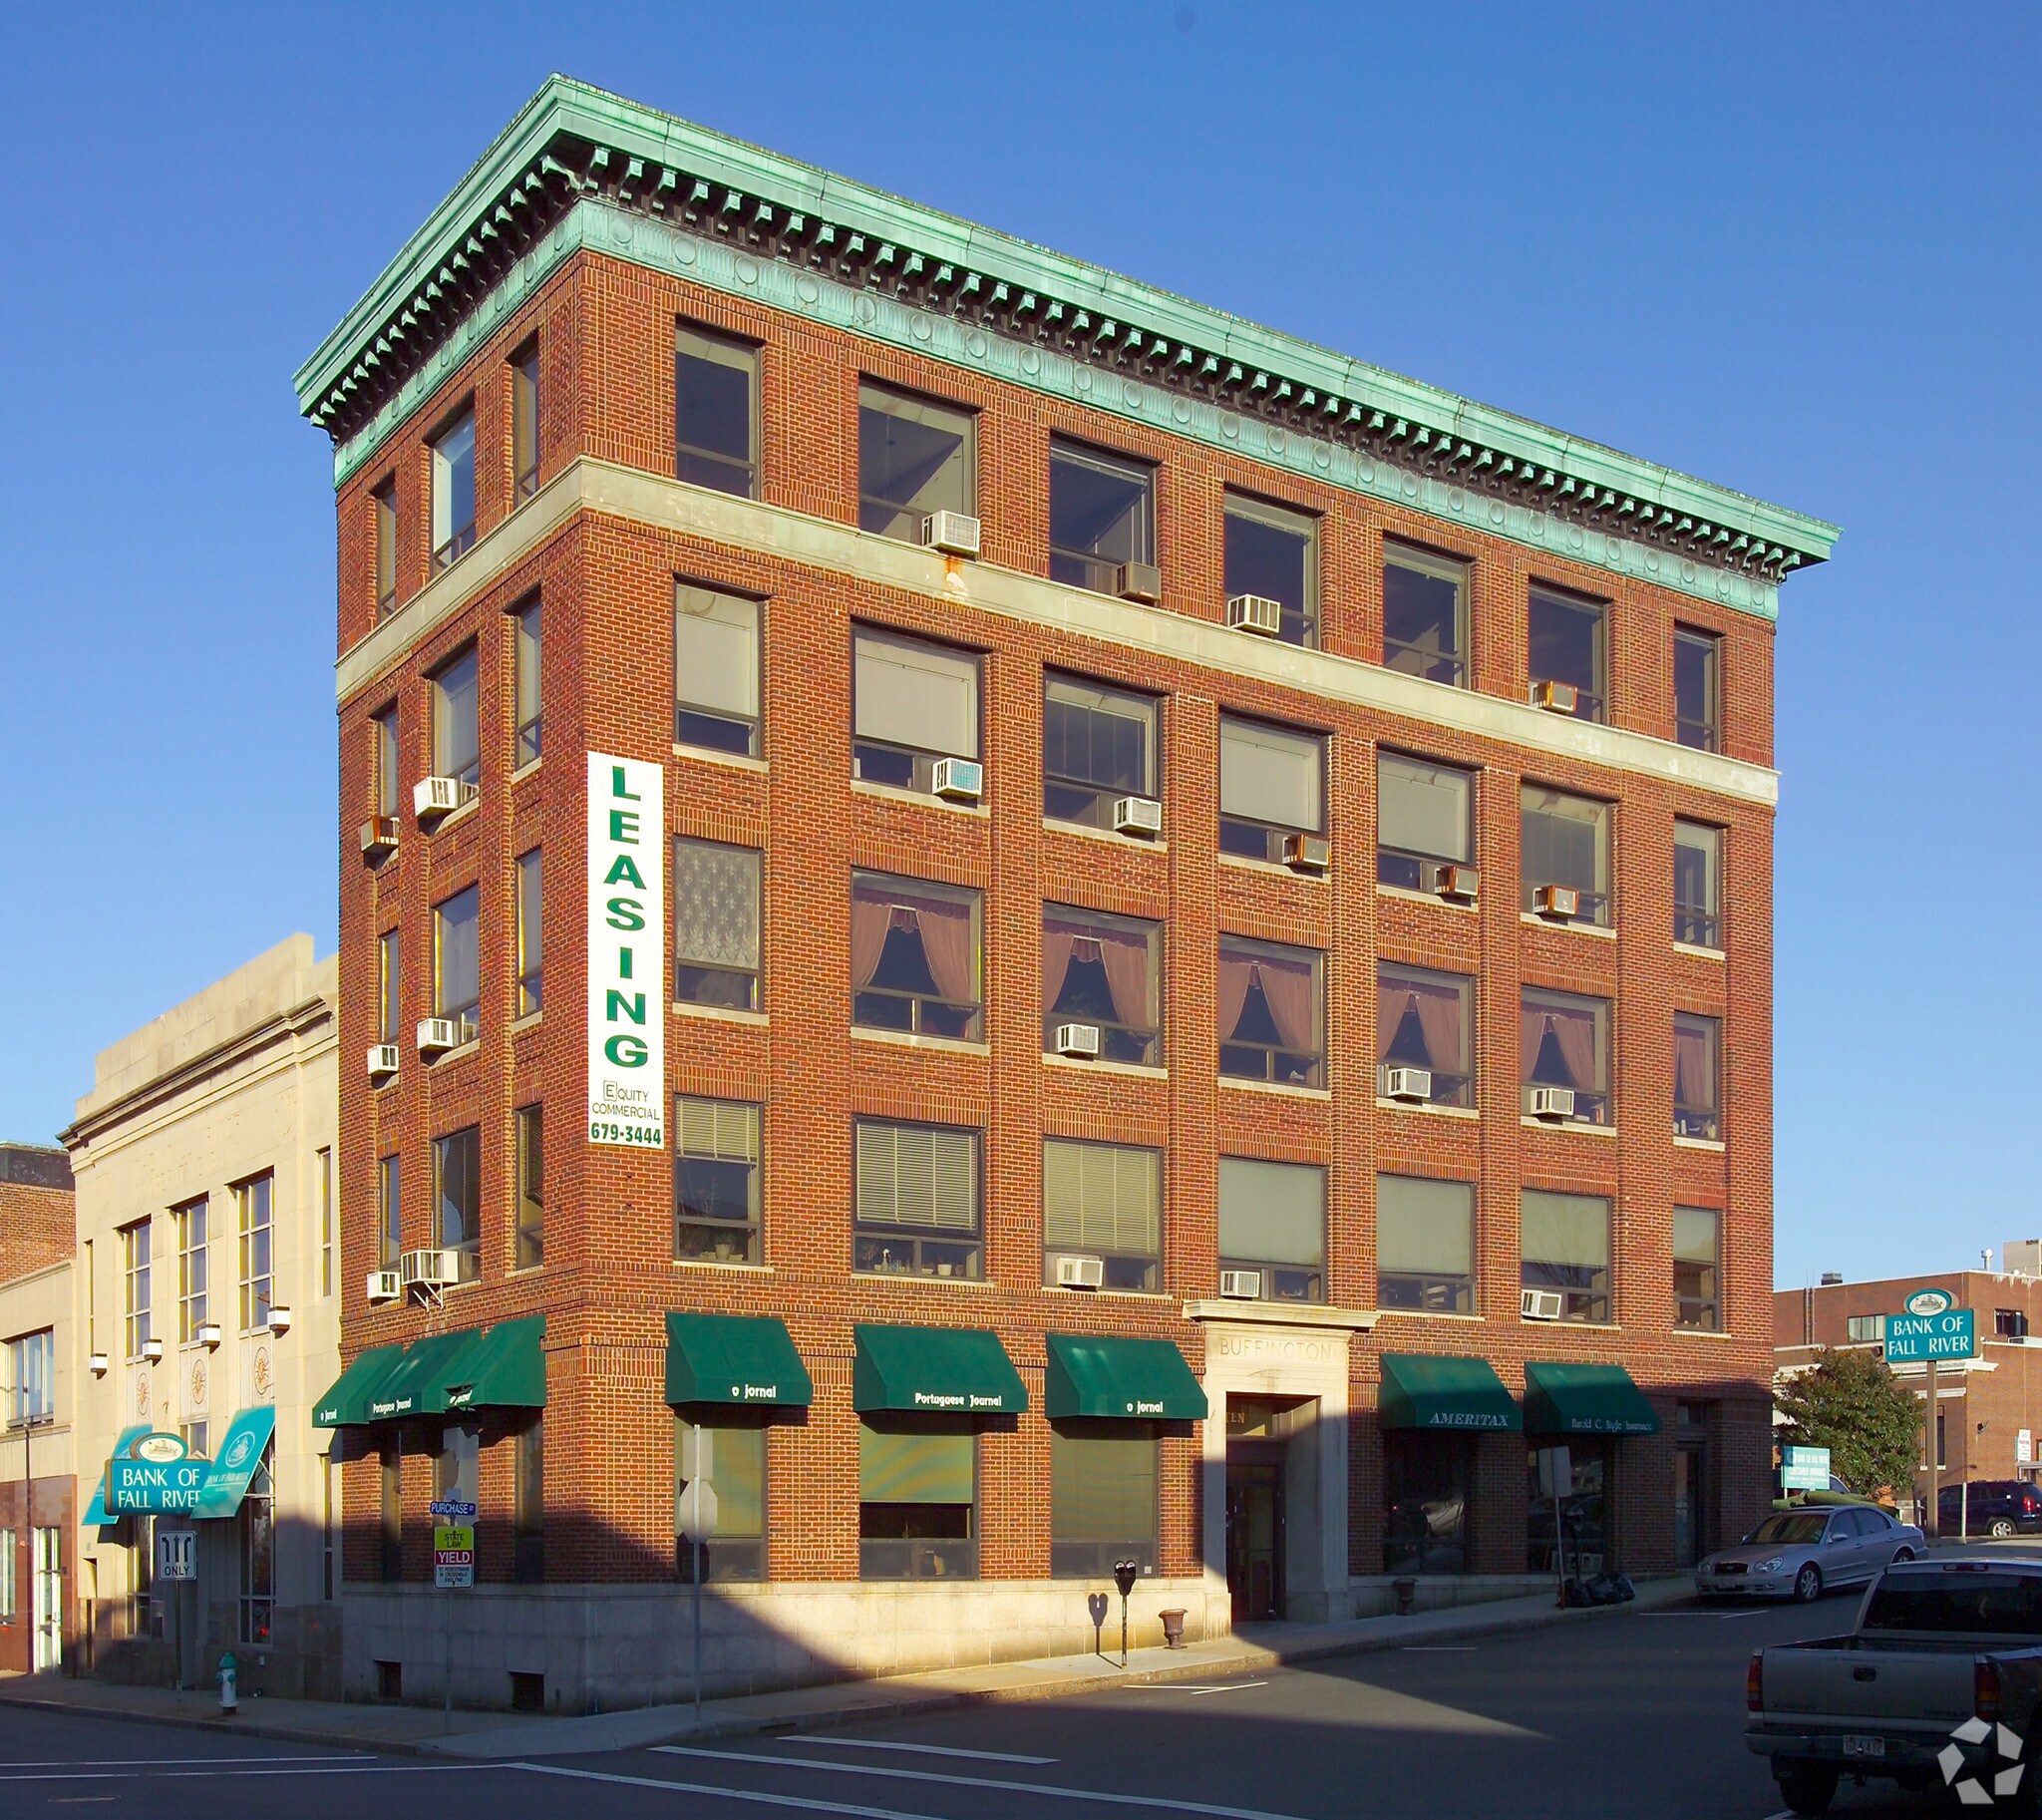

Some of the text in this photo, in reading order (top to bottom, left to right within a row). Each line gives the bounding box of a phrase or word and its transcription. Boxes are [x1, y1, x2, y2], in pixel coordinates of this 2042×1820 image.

[603, 765, 648, 1068] LEASING
[592, 1102, 660, 1120] COMMERCIAL
[591, 1122, 661, 1144] 679-3444
[1893, 1316, 1963, 1336] BANK OF
[1219, 1337, 1331, 1359] BUFFINGTON
[1888, 1335, 1969, 1356] FALL RIVER
[744, 1384, 777, 1399] jornal
[914, 1392, 1002, 1407] Portuguese Journal
[1137, 1400, 1164, 1415] jornal
[1429, 1412, 1509, 1427] AMERITAX
[123, 1468, 199, 1487] BANK OF
[118, 1490, 152, 1508] FALL
[431, 1502, 469, 1514] PURCHASE
[439, 1552, 470, 1564] YIELD
[164, 1566, 189, 1576] ONLY
